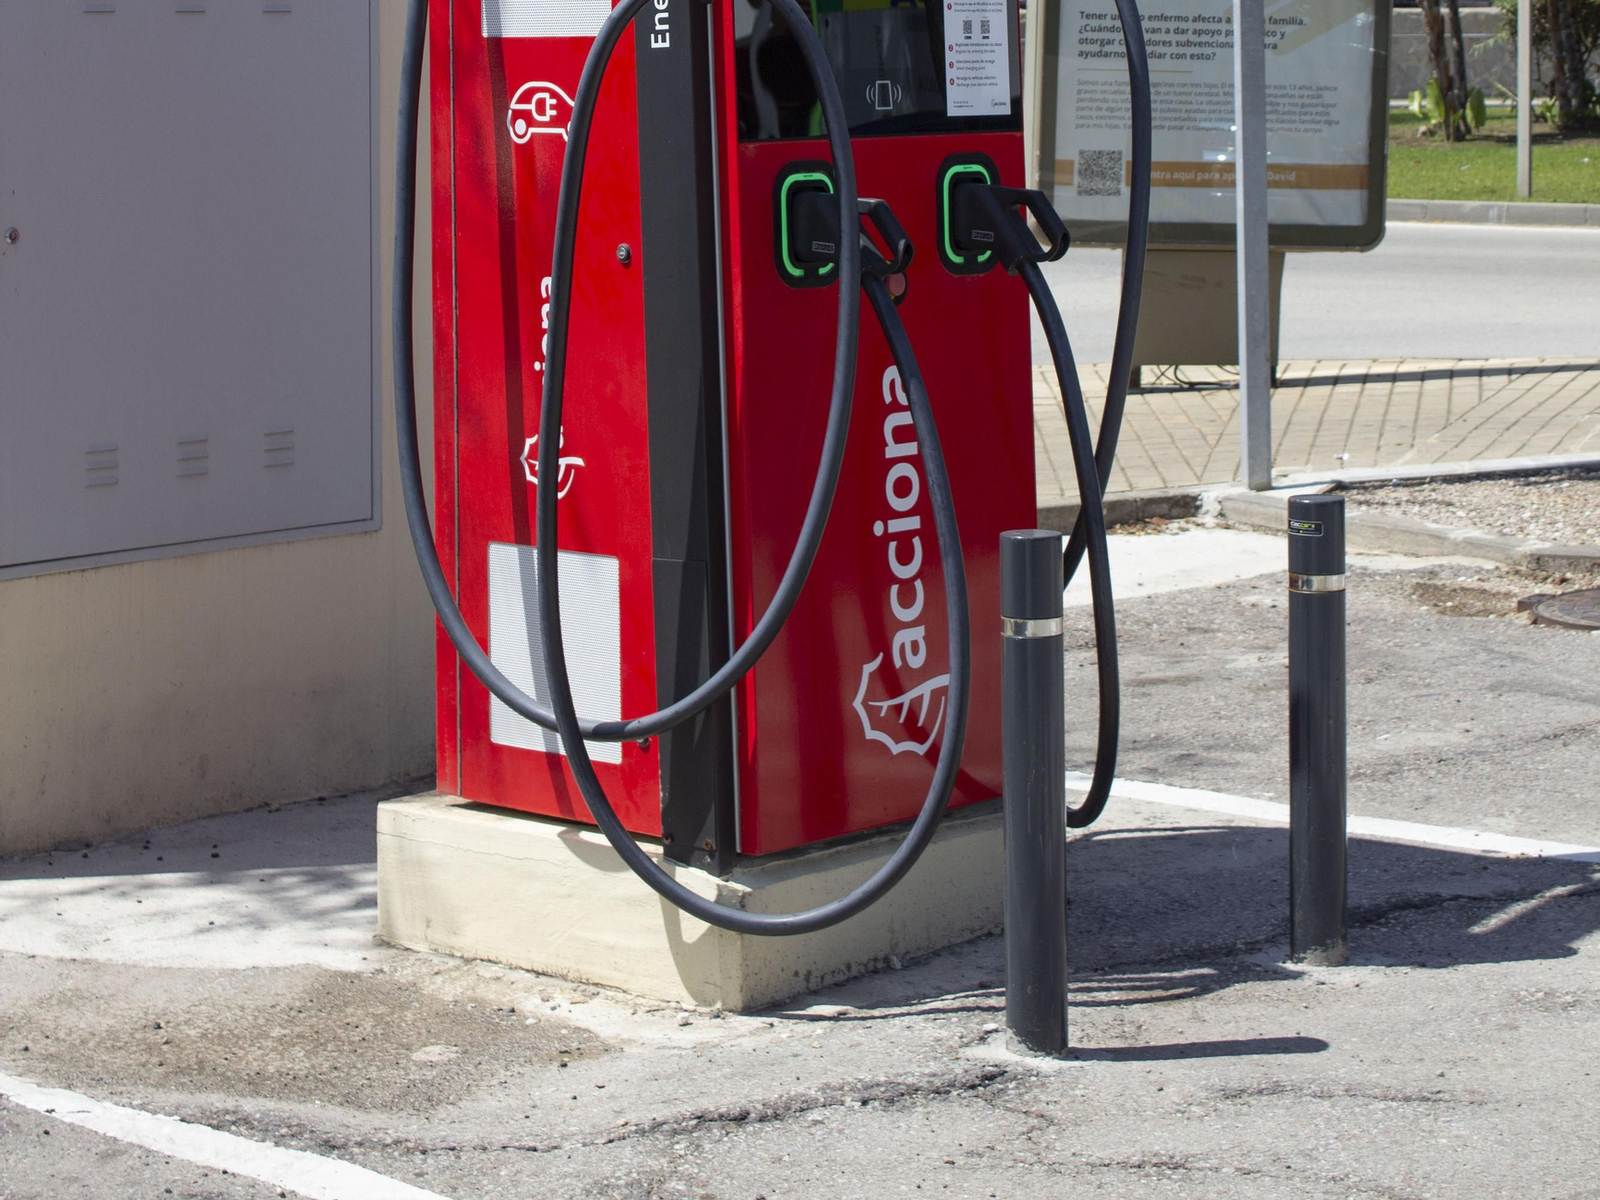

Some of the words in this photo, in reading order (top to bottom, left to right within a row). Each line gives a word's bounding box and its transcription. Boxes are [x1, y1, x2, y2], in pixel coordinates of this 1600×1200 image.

[1079, 11, 1108, 20] Tener
[1148, 13, 1190, 22] enfermo
[1192, 14, 1223, 23] afecta
[1268, 16, 1306, 26] familia.
[1078, 23, 1122, 34] ¿Cuándo
[1173, 26, 1190, 35] dar
[1192, 28, 1222, 38] apoyo
[1280, 30, 1286, 39] y
[1078, 37, 1116, 47] otorgar
[1077, 49, 1126, 59] ayudarno
[1170, 52, 1187, 60] con
[1189, 52, 1217, 60] esto?
[1173, 171, 1195, 181] aquí
[1197, 172, 1220, 182] para
[1267, 171, 1296, 181] David
[873, 364, 927, 670] acciona
